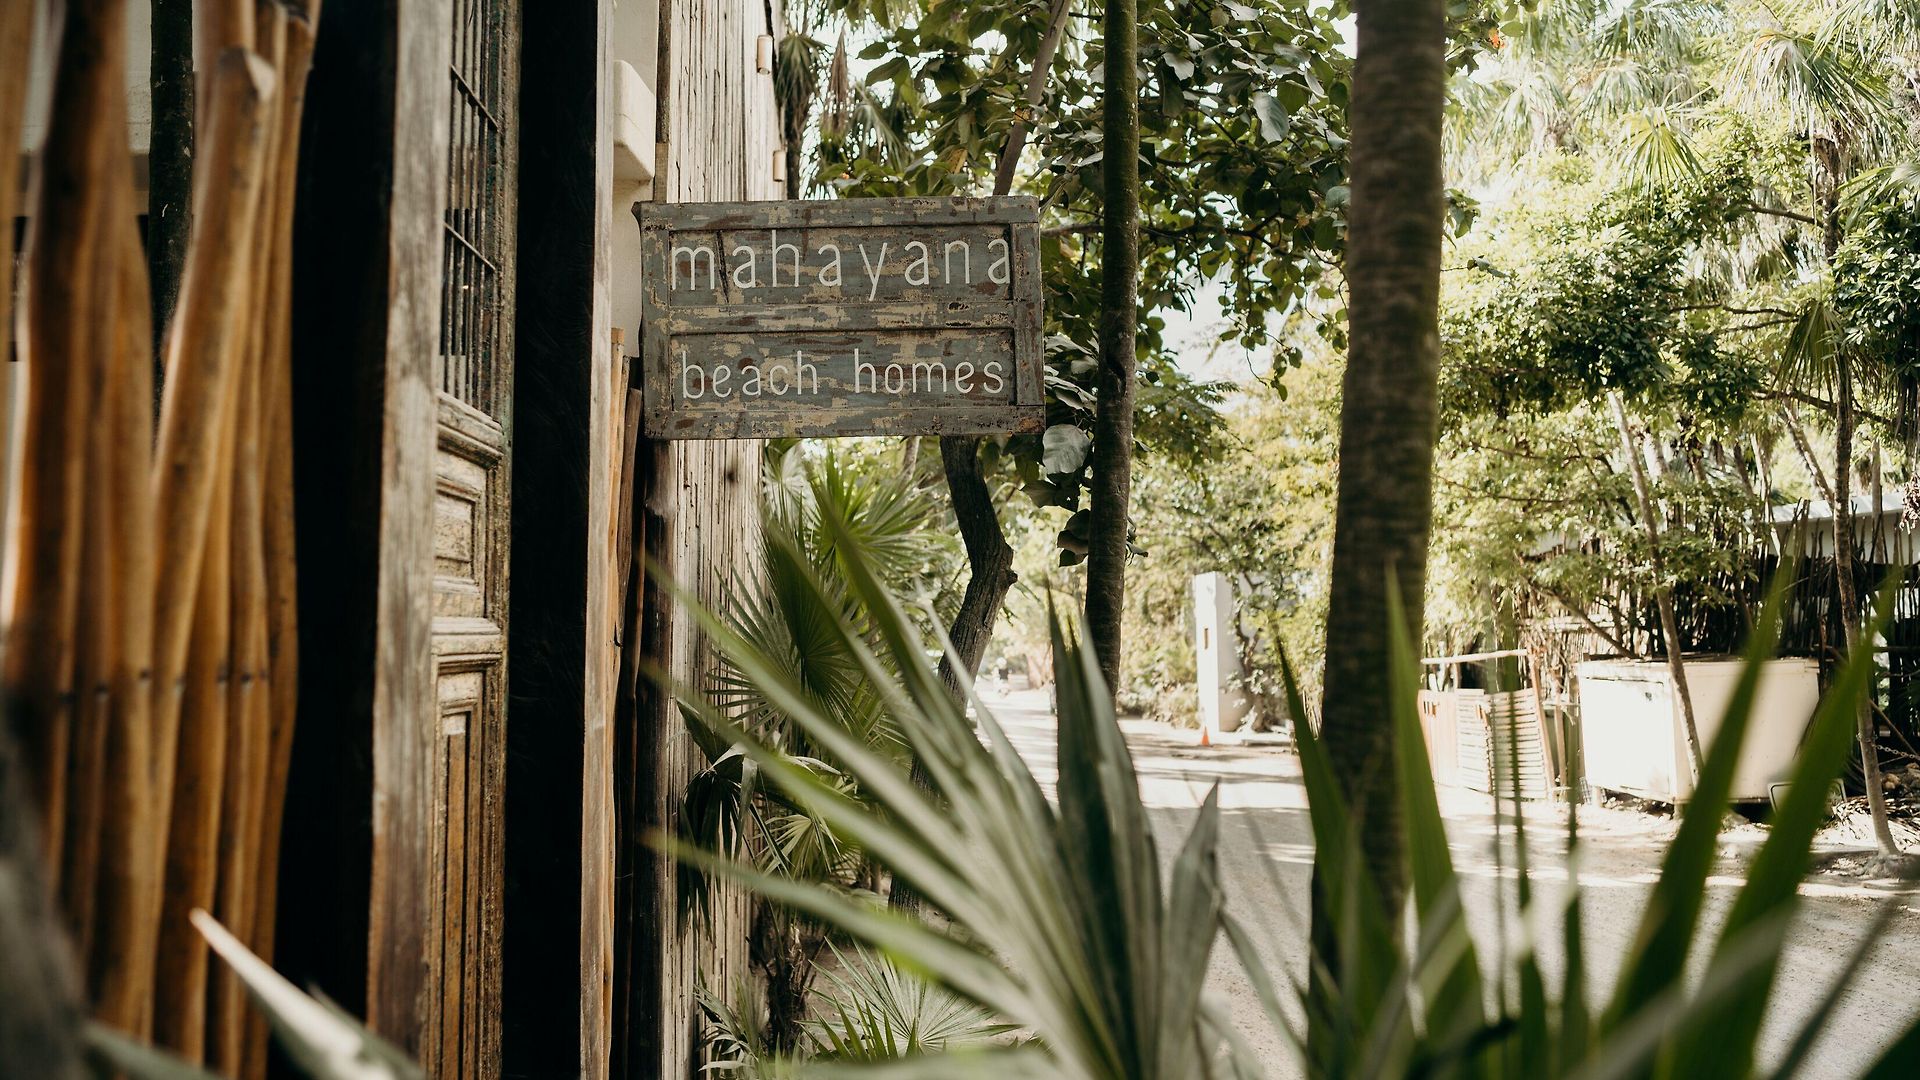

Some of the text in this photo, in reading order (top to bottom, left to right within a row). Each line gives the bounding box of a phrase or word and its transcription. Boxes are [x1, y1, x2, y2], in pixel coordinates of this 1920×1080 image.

[670, 229, 1012, 301] mahayana
[681, 347, 1004, 399] beach homes
